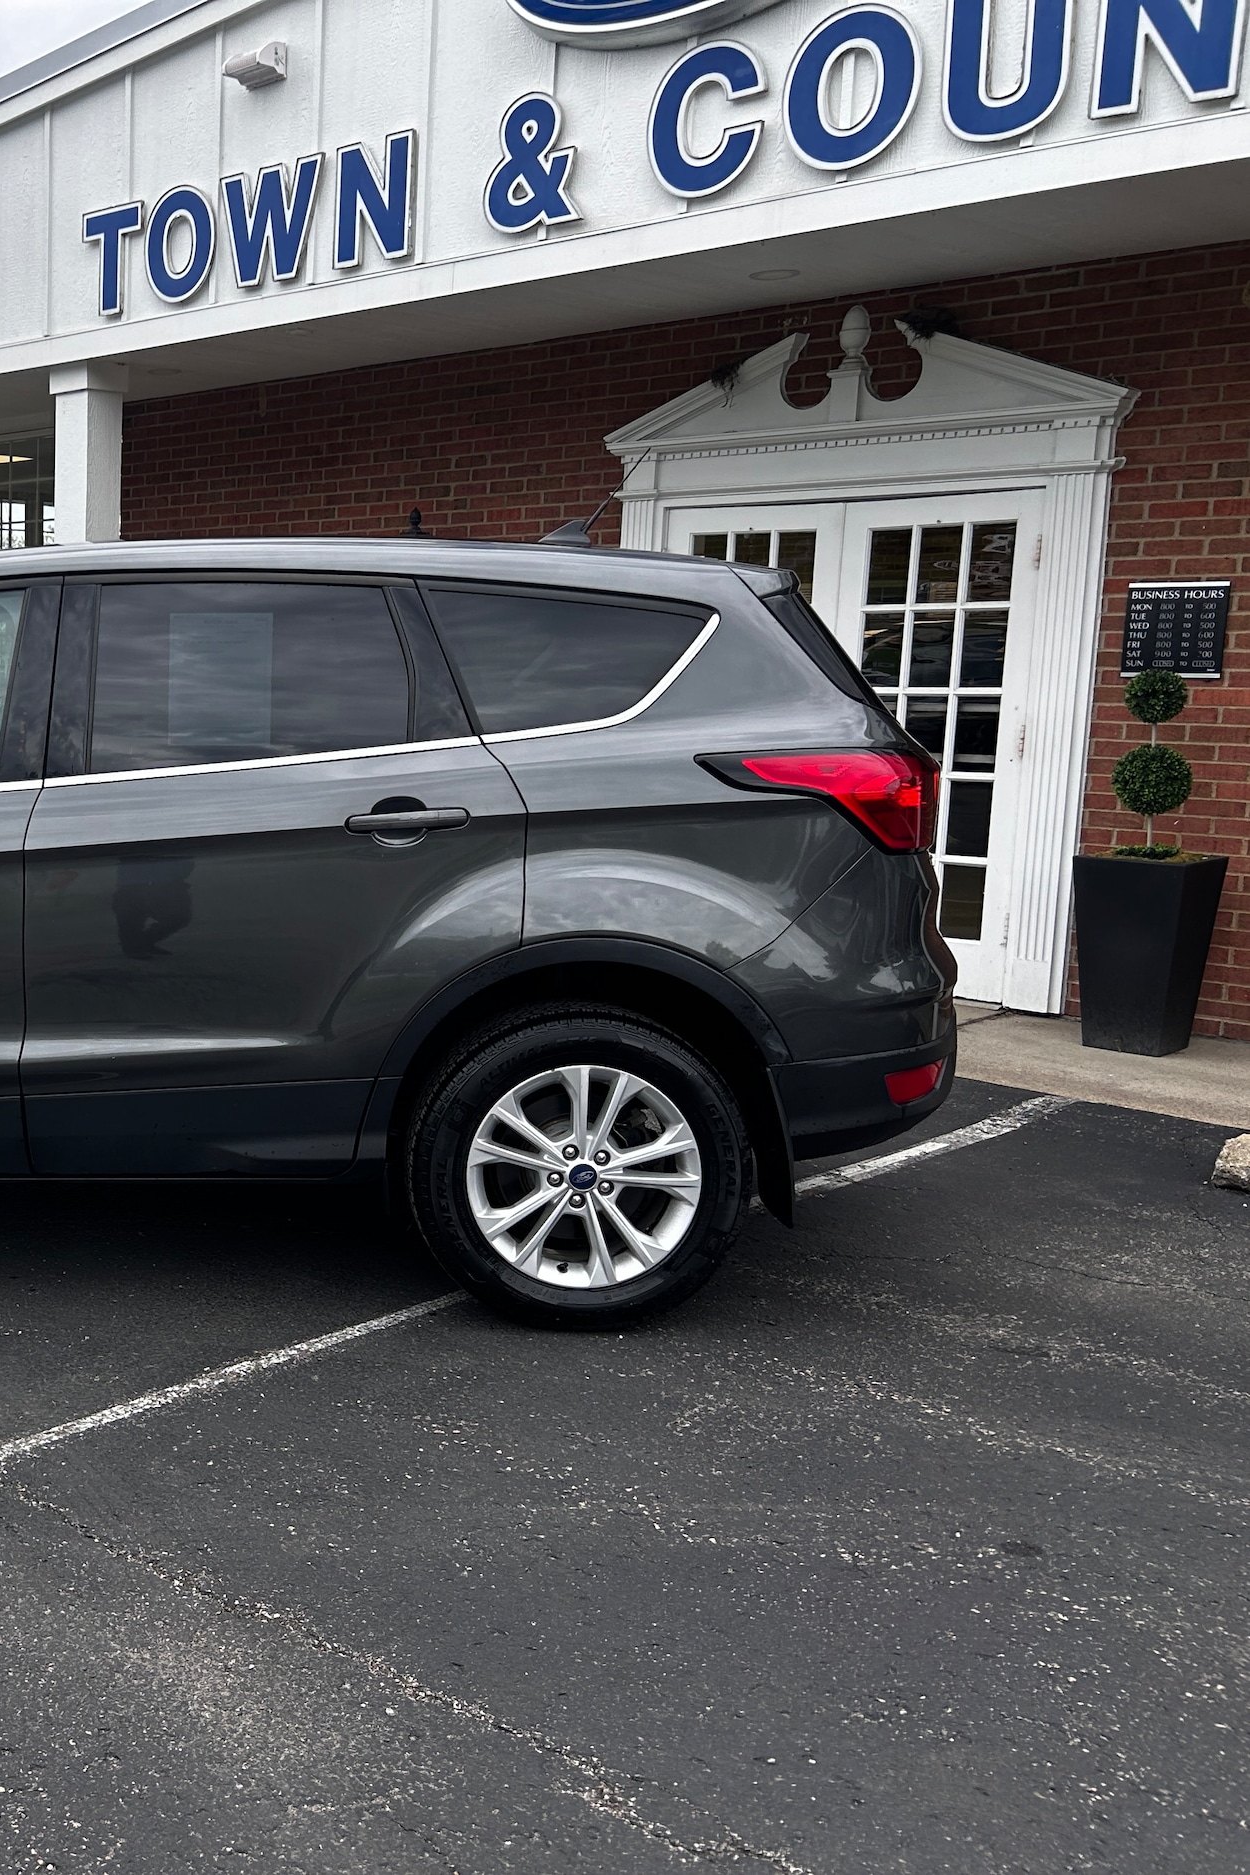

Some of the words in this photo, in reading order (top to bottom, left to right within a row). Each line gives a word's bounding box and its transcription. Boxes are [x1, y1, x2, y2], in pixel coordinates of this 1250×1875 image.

[81, 128, 416, 316] TOWN
[482, 91, 583, 235] &
[646, 0, 1244, 199] COUN
[1131, 590, 1180, 600] BUSINESS
[1184, 589, 1225, 599] HOURS
[1131, 603, 1153, 611] MON
[1131, 612, 1147, 620] TUE
[1129, 631, 1147, 639] THU
[1126, 650, 1141, 658] SAT
